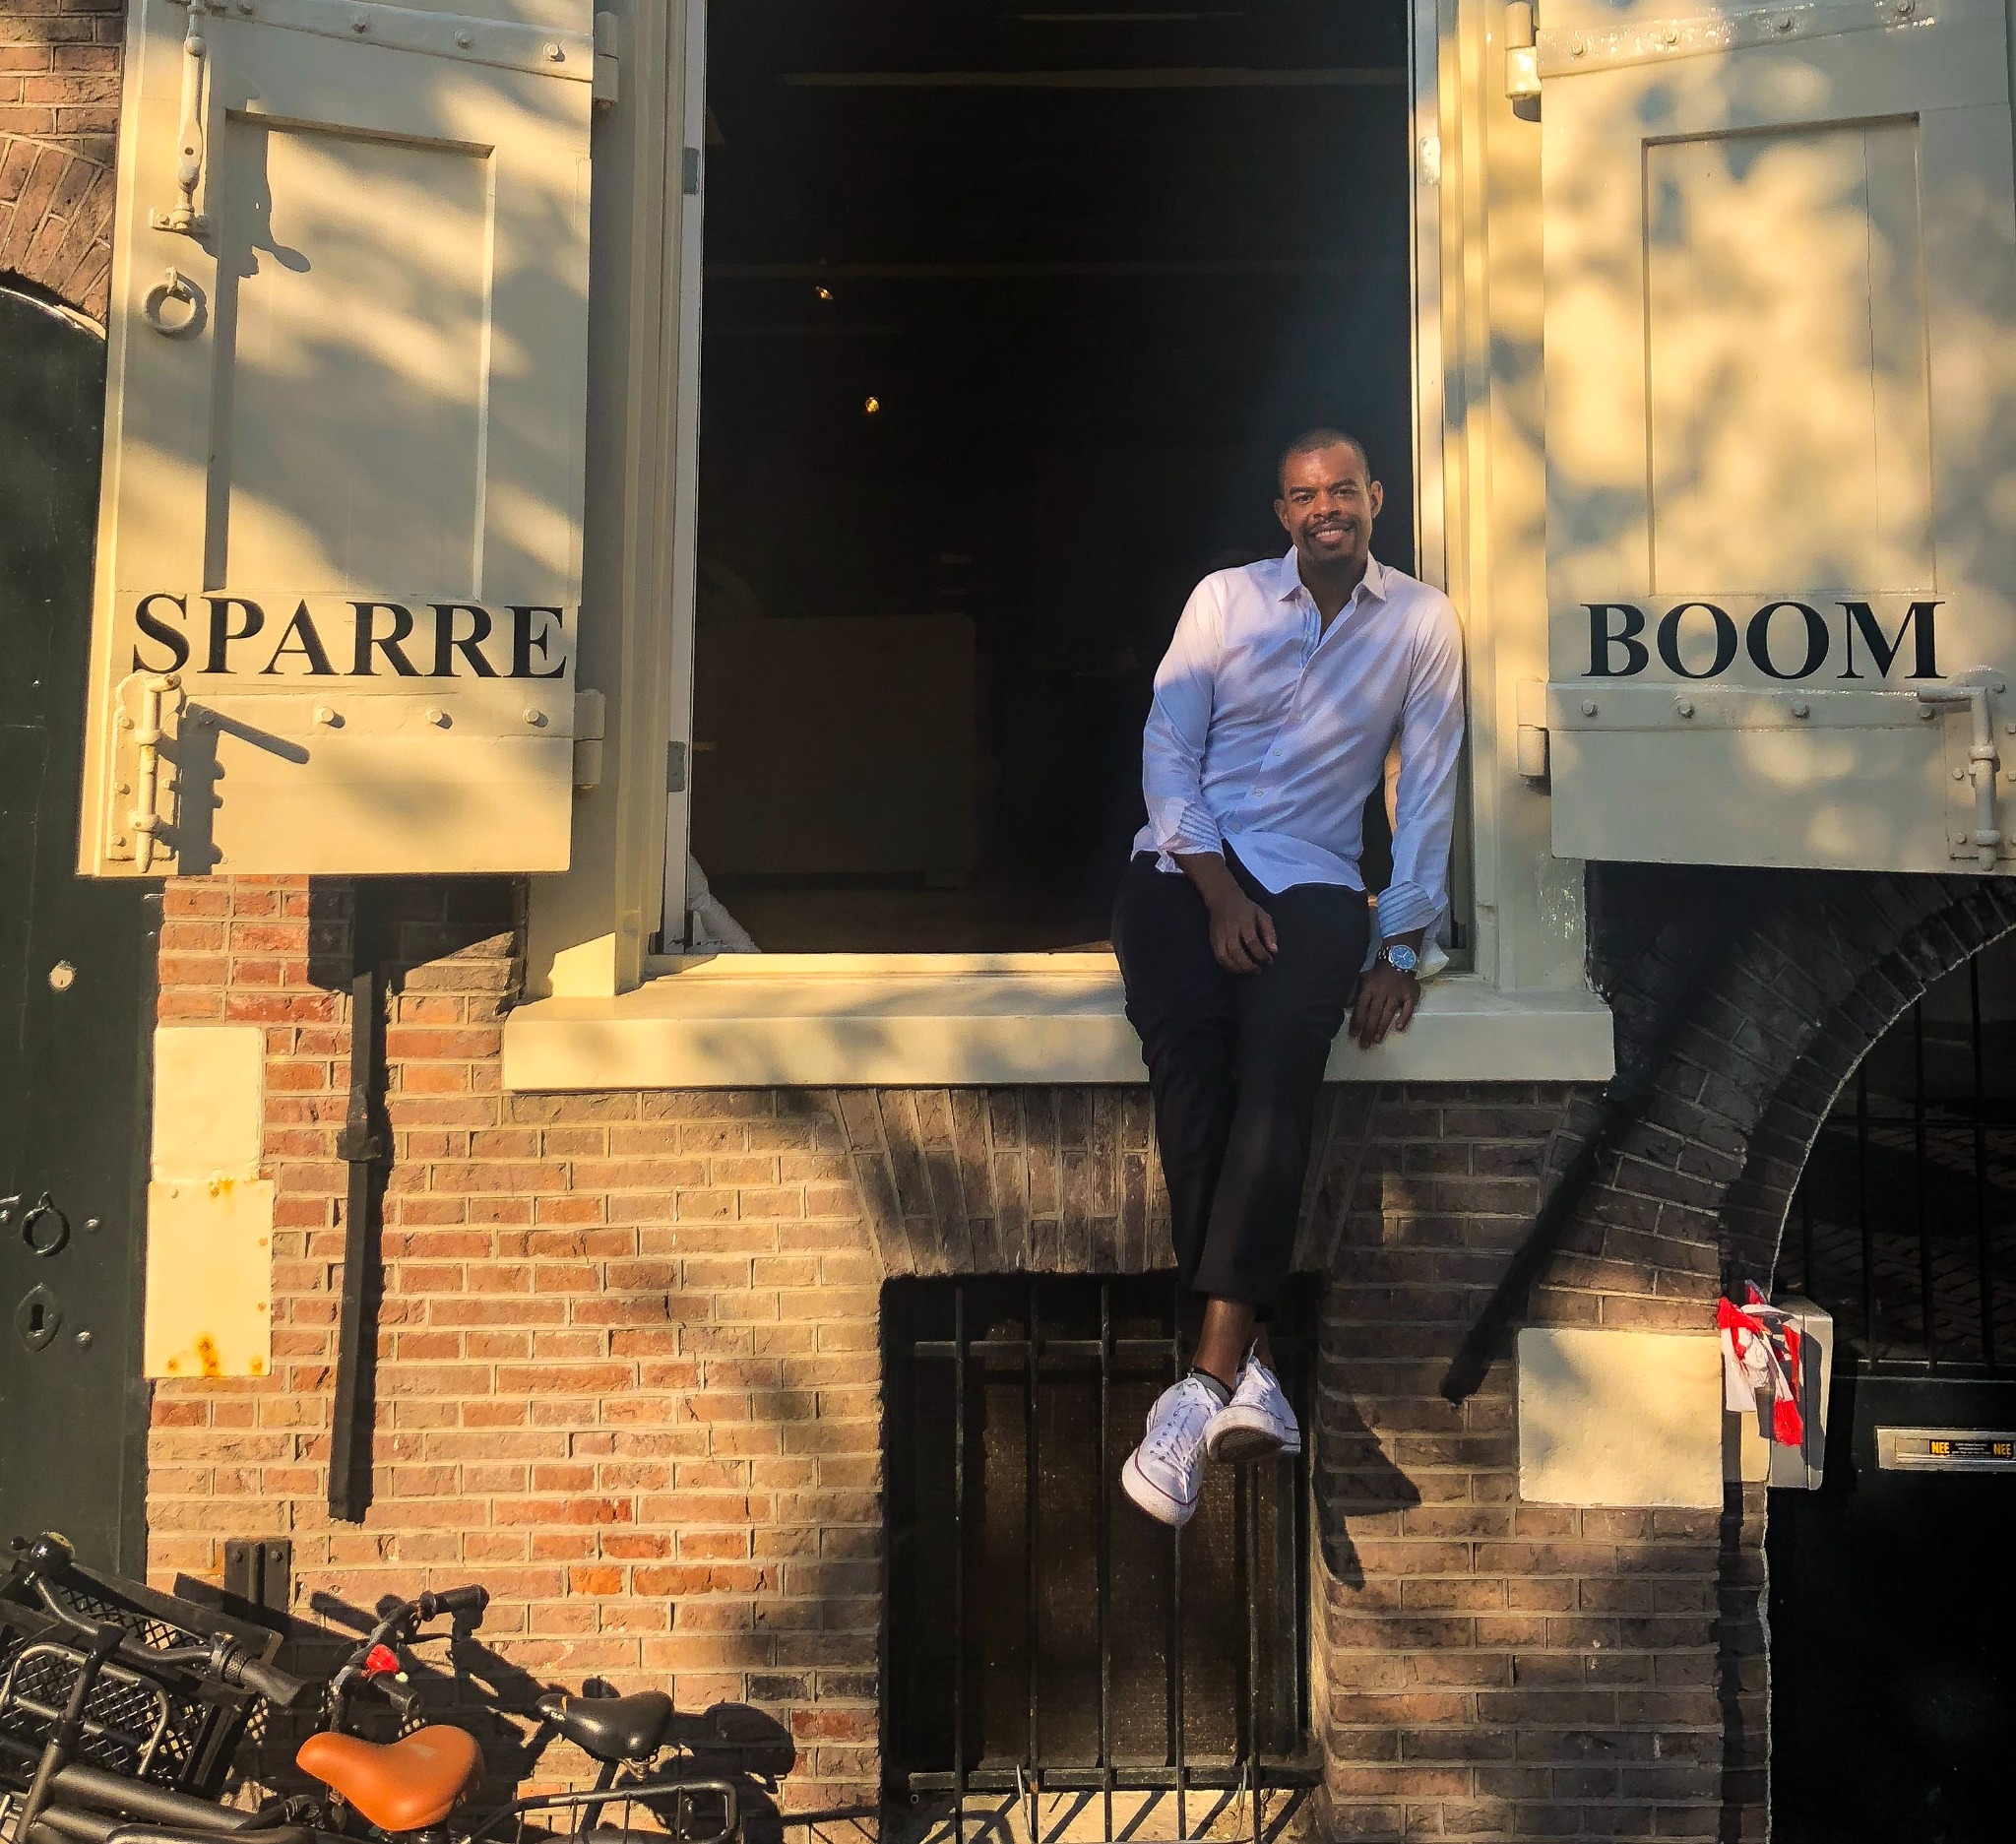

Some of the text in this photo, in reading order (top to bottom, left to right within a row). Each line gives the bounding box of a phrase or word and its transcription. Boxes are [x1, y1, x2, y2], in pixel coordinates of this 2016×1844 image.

[132, 593, 567, 678] SPARRE
[1580, 602, 1948, 679] BOOM
[1931, 1441, 1950, 1454] NEE
[1993, 1443, 2012, 1455] NEE
